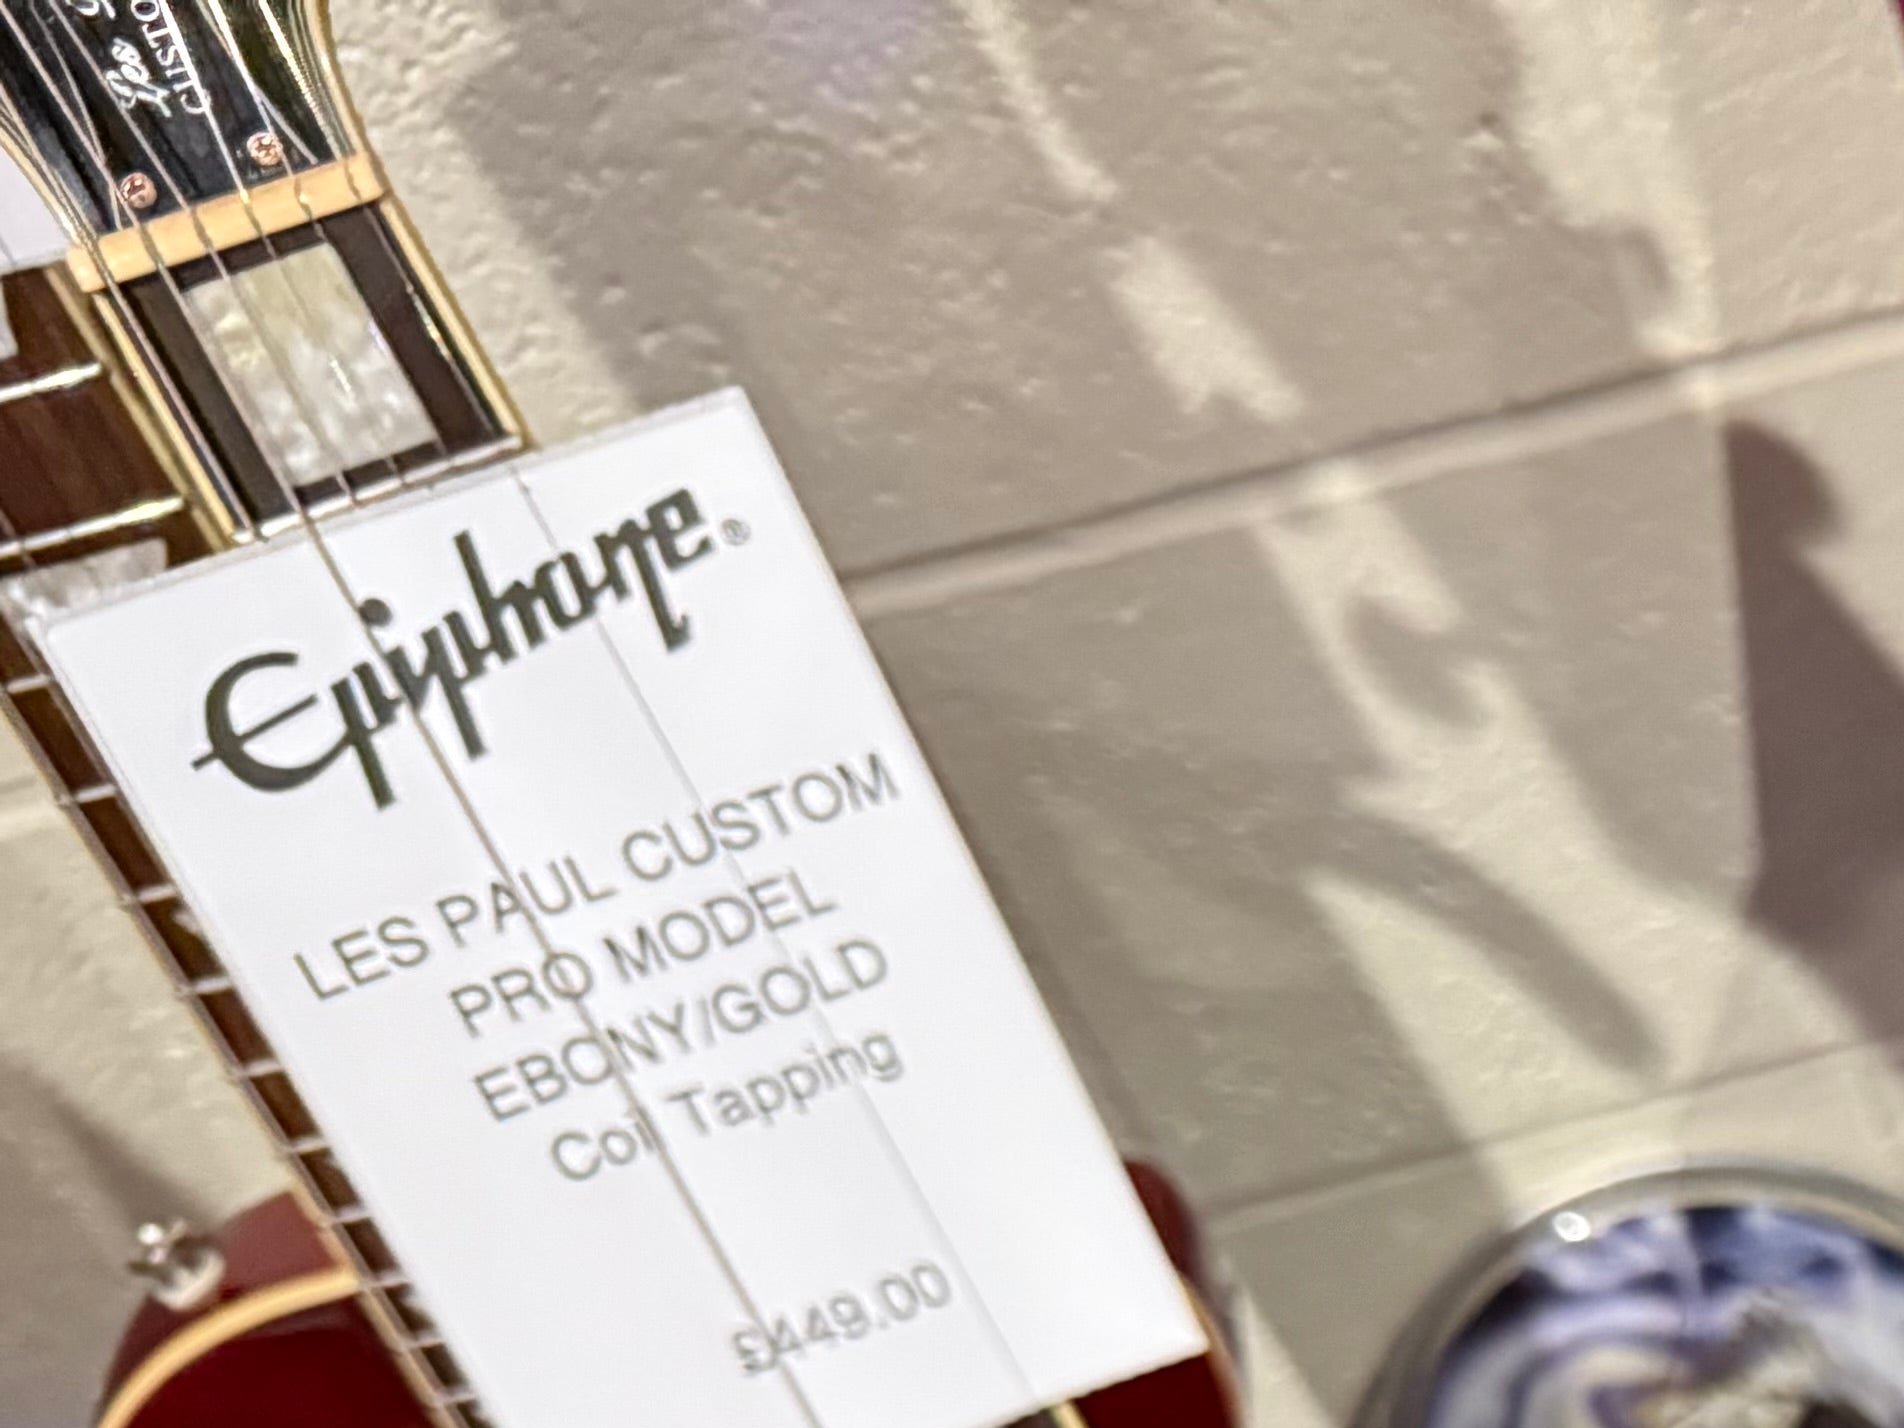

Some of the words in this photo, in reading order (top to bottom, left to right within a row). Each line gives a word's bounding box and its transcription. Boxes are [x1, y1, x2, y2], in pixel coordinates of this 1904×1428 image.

[191, 488, 716, 812] Epiphone
[293, 917, 431, 1001] LES
[436, 856, 619, 948] PAUL
[621, 753, 900, 883] CUSTOM
[448, 951, 595, 1038] PRO
[602, 870, 839, 985] MODEL
[472, 938, 888, 1122] EBONY/GOLD
[665, 1032, 905, 1137] Tapping
[731, 1262, 952, 1377] £449.00
